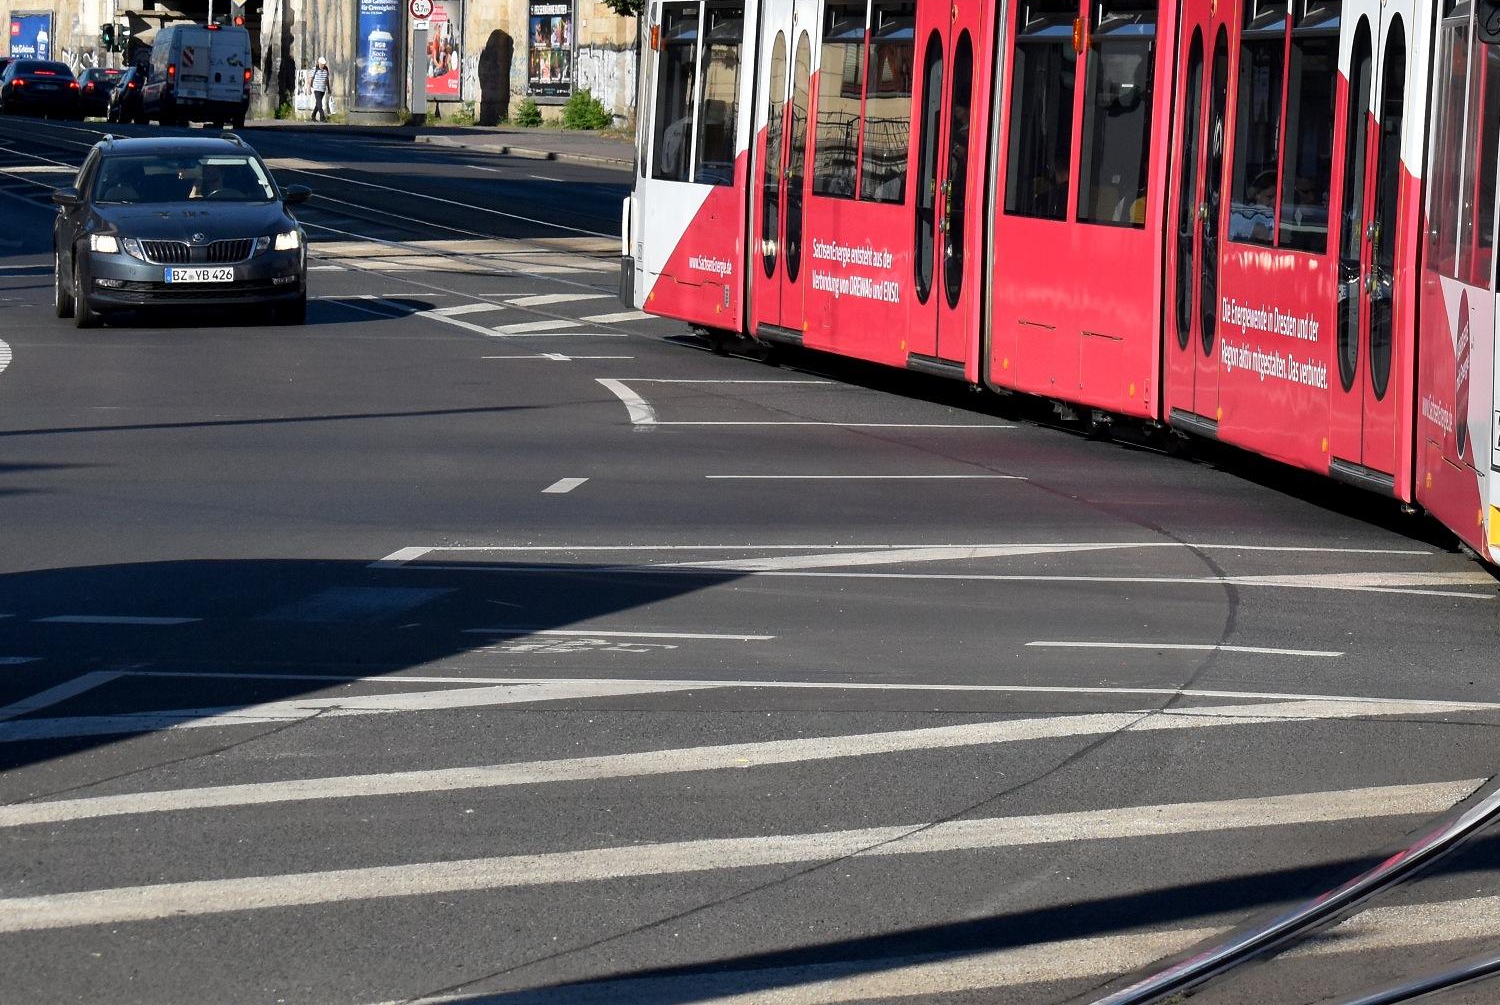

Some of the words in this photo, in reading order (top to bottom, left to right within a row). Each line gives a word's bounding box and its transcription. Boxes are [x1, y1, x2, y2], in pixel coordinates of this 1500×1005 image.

[812, 238, 851, 268] SachsenEnergie
[850, 245, 873, 266] entsteht
[873, 251, 882, 268] aus
[882, 247, 893, 269] der
[172, 270, 187, 281] BZ
[195, 269, 210, 281] YB
[212, 269, 233, 281] 426
[812, 269, 840, 298] Verbindung
[840, 277, 849, 295] von
[849, 275, 873, 298] DREWAG
[873, 280, 883, 301] und
[883, 280, 900, 303] ENSO.
[1222, 296, 1231, 324] Die
[1231, 298, 1267, 334] Energiewende
[1267, 305, 1273, 332] in
[1274, 306, 1297, 337] Dresden
[1297, 312, 1308, 340] und
[1308, 312, 1319, 342] der
[1221, 337, 1239, 373] Region
[1239, 342, 1252, 370] aktiv
[1251, 345, 1287, 381] mitgestalten.
[1288, 353, 1299, 383] Das
[1299, 357, 1328, 389] verbindet.
